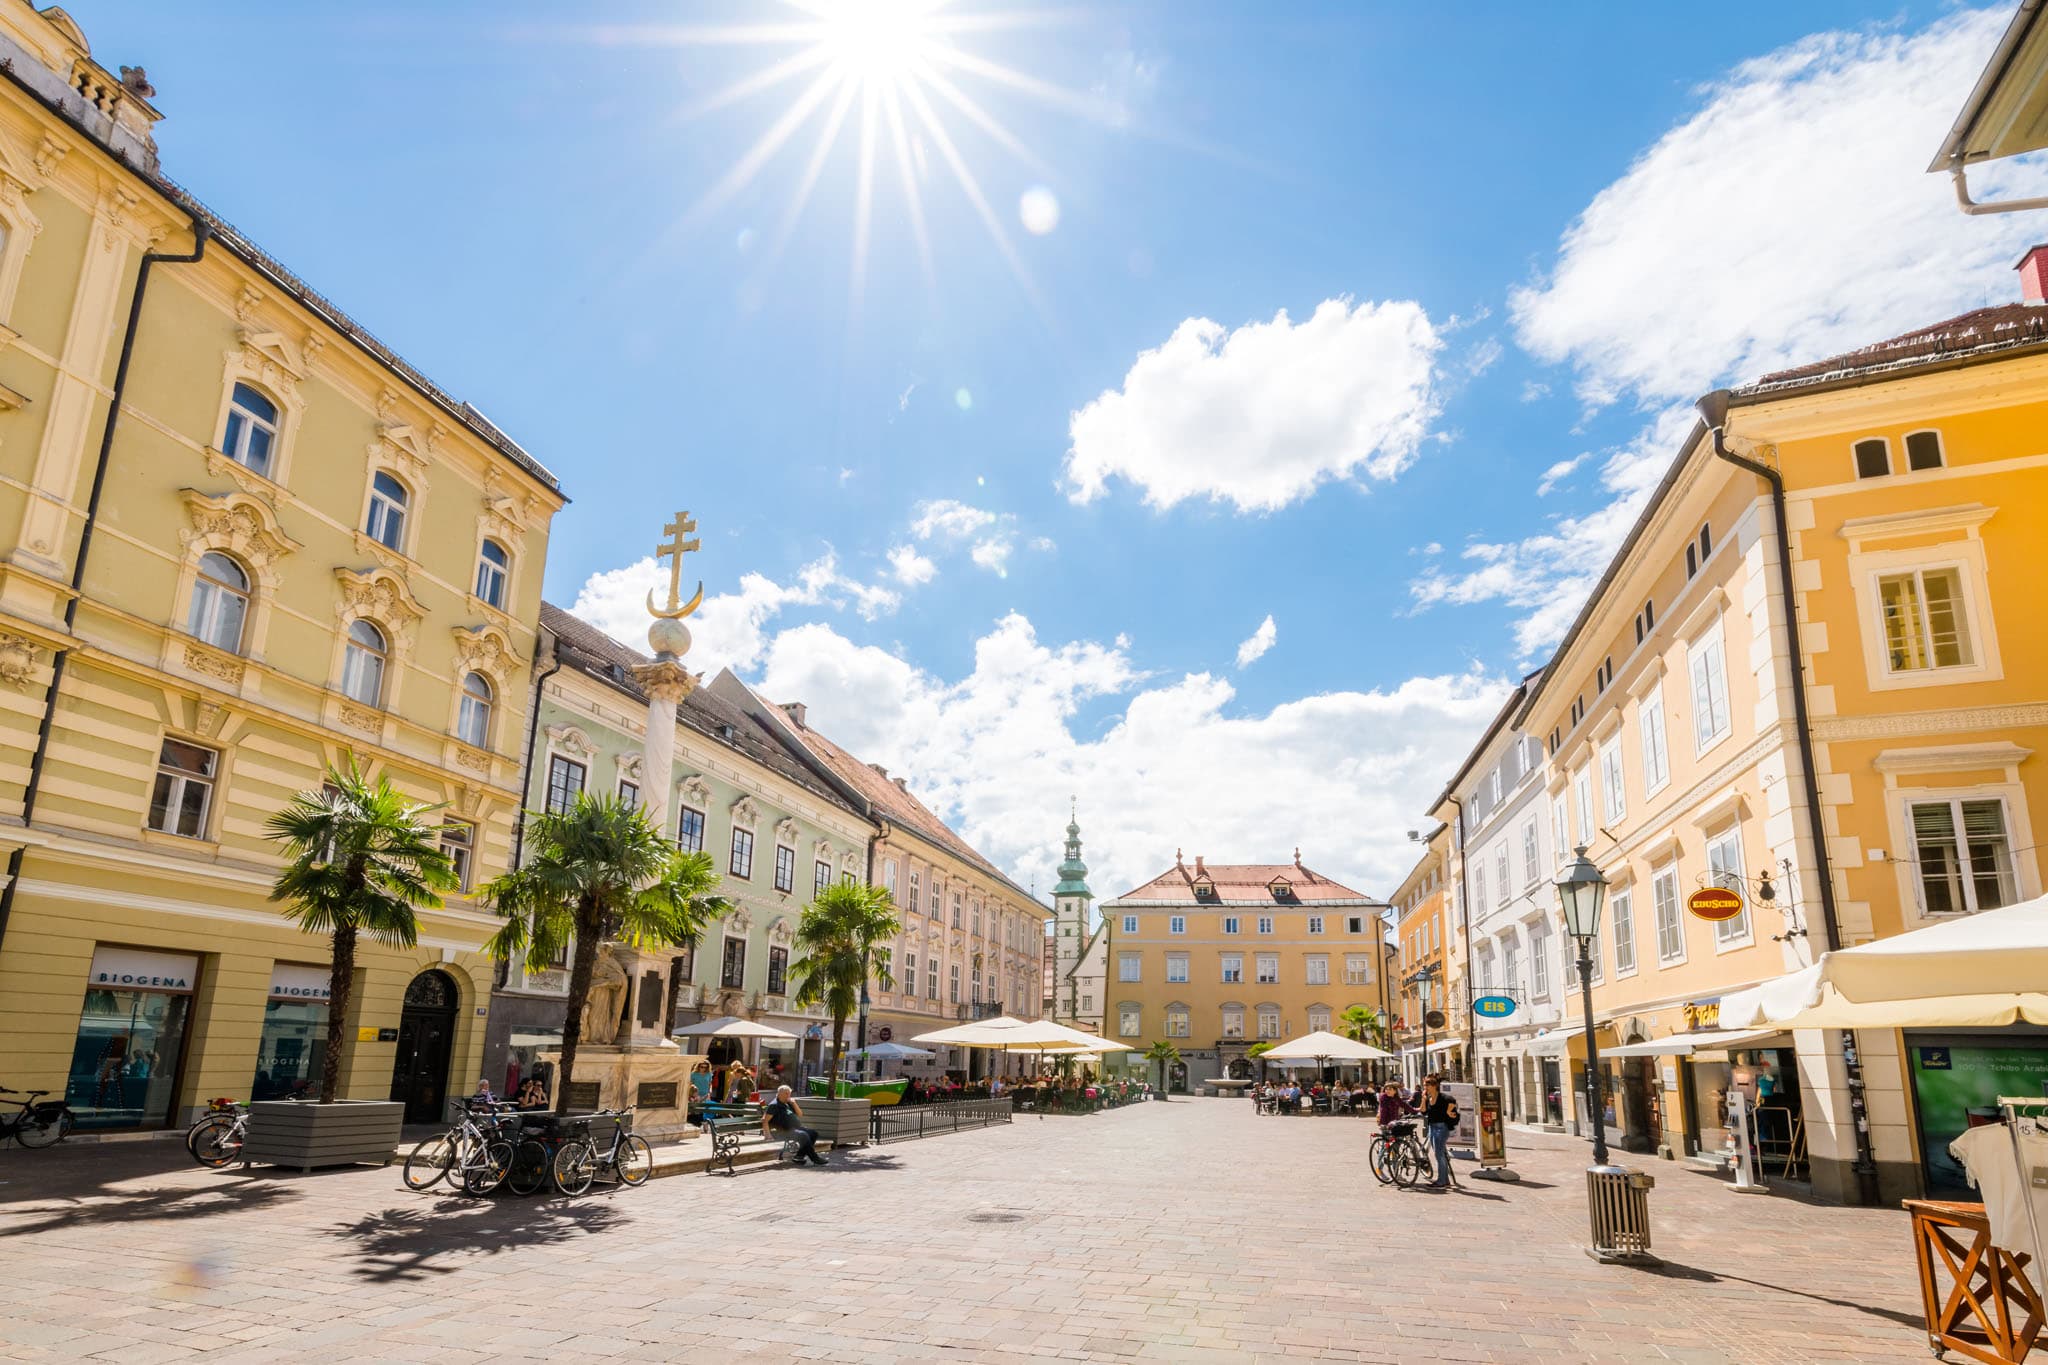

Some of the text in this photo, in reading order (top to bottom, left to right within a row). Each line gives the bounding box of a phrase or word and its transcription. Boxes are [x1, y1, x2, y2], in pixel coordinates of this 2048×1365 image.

[1692, 899, 1739, 909] EDUSCHO
[99, 972, 186, 988] BIOGENA
[1483, 1001, 1506, 1013] EIS
[1990, 1064, 2020, 1072] Tchibo
